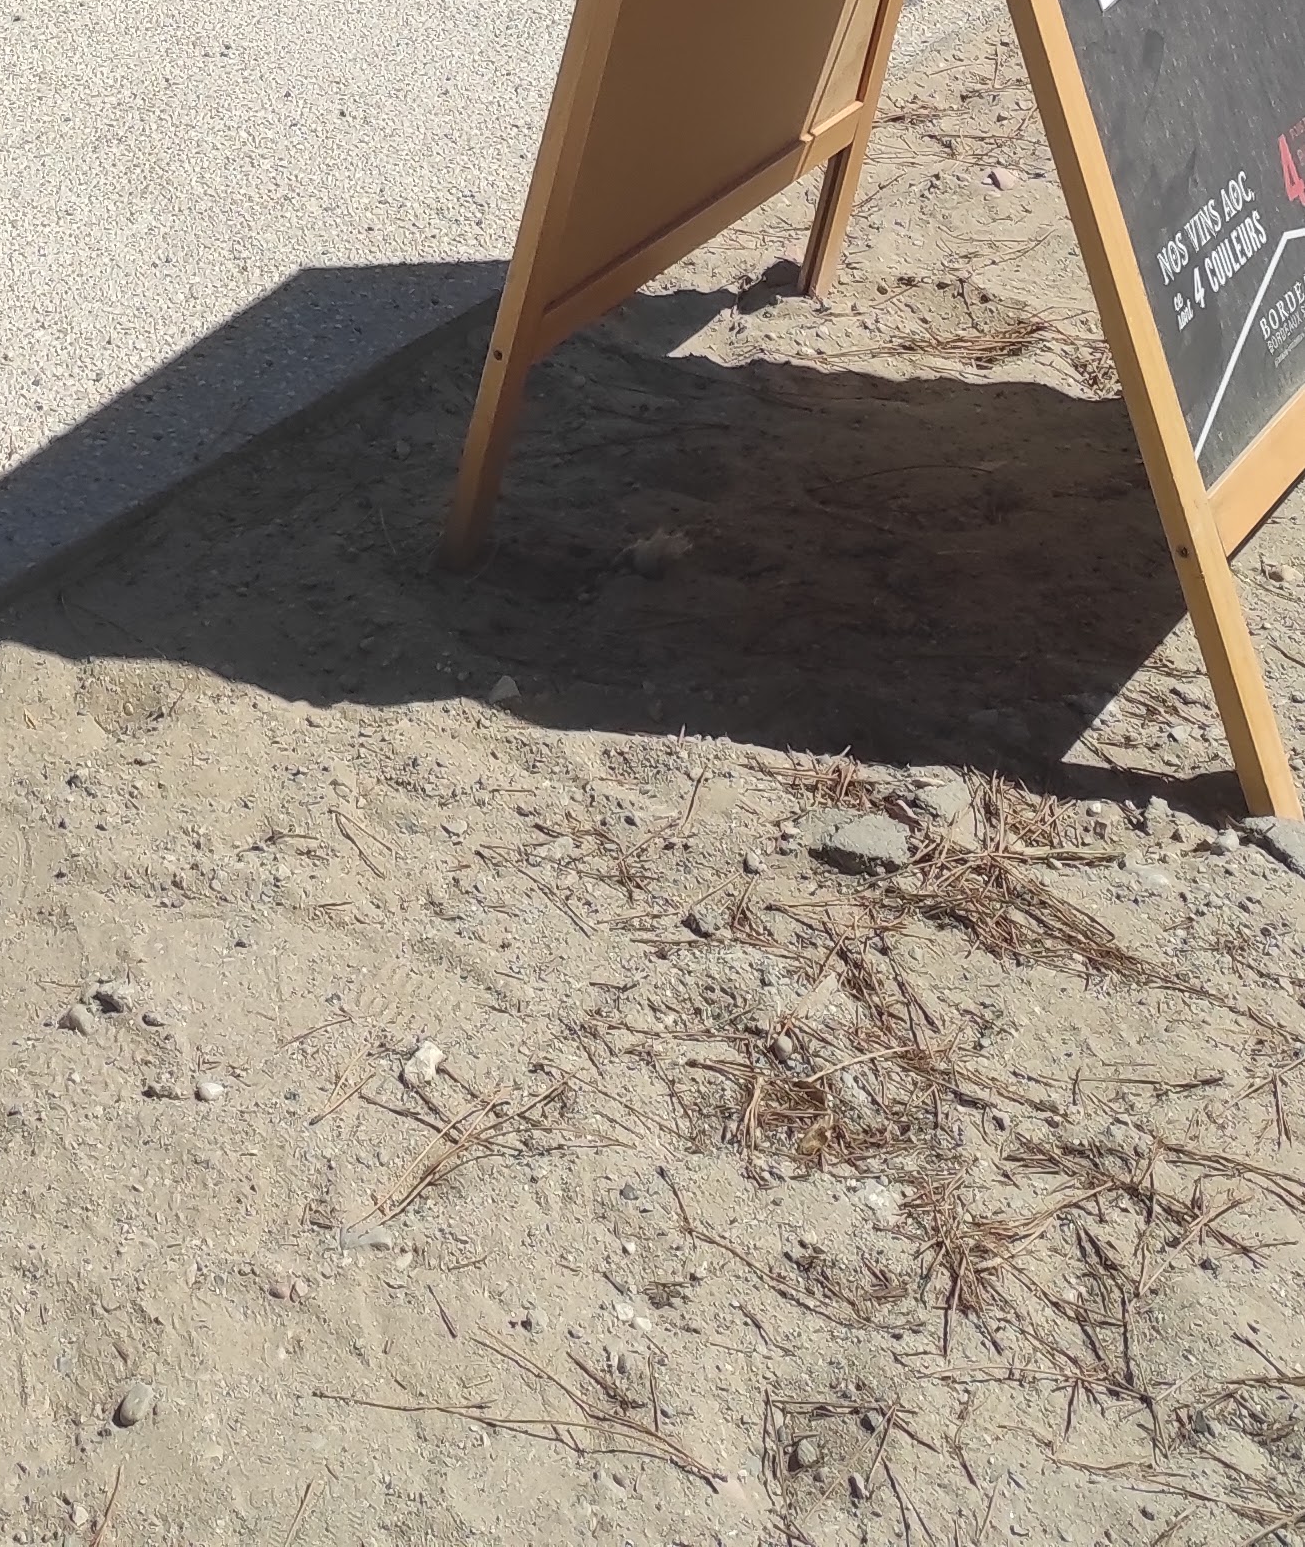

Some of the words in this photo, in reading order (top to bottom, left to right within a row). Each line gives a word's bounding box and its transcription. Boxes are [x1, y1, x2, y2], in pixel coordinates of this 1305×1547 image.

[1156, 231, 1189, 285] NOS
[1184, 198, 1222, 253] VINS
[1194, 266, 1206, 309] 4
[1204, 209, 1267, 293] COULEURS
[1260, 273, 1305, 340] BORDE
